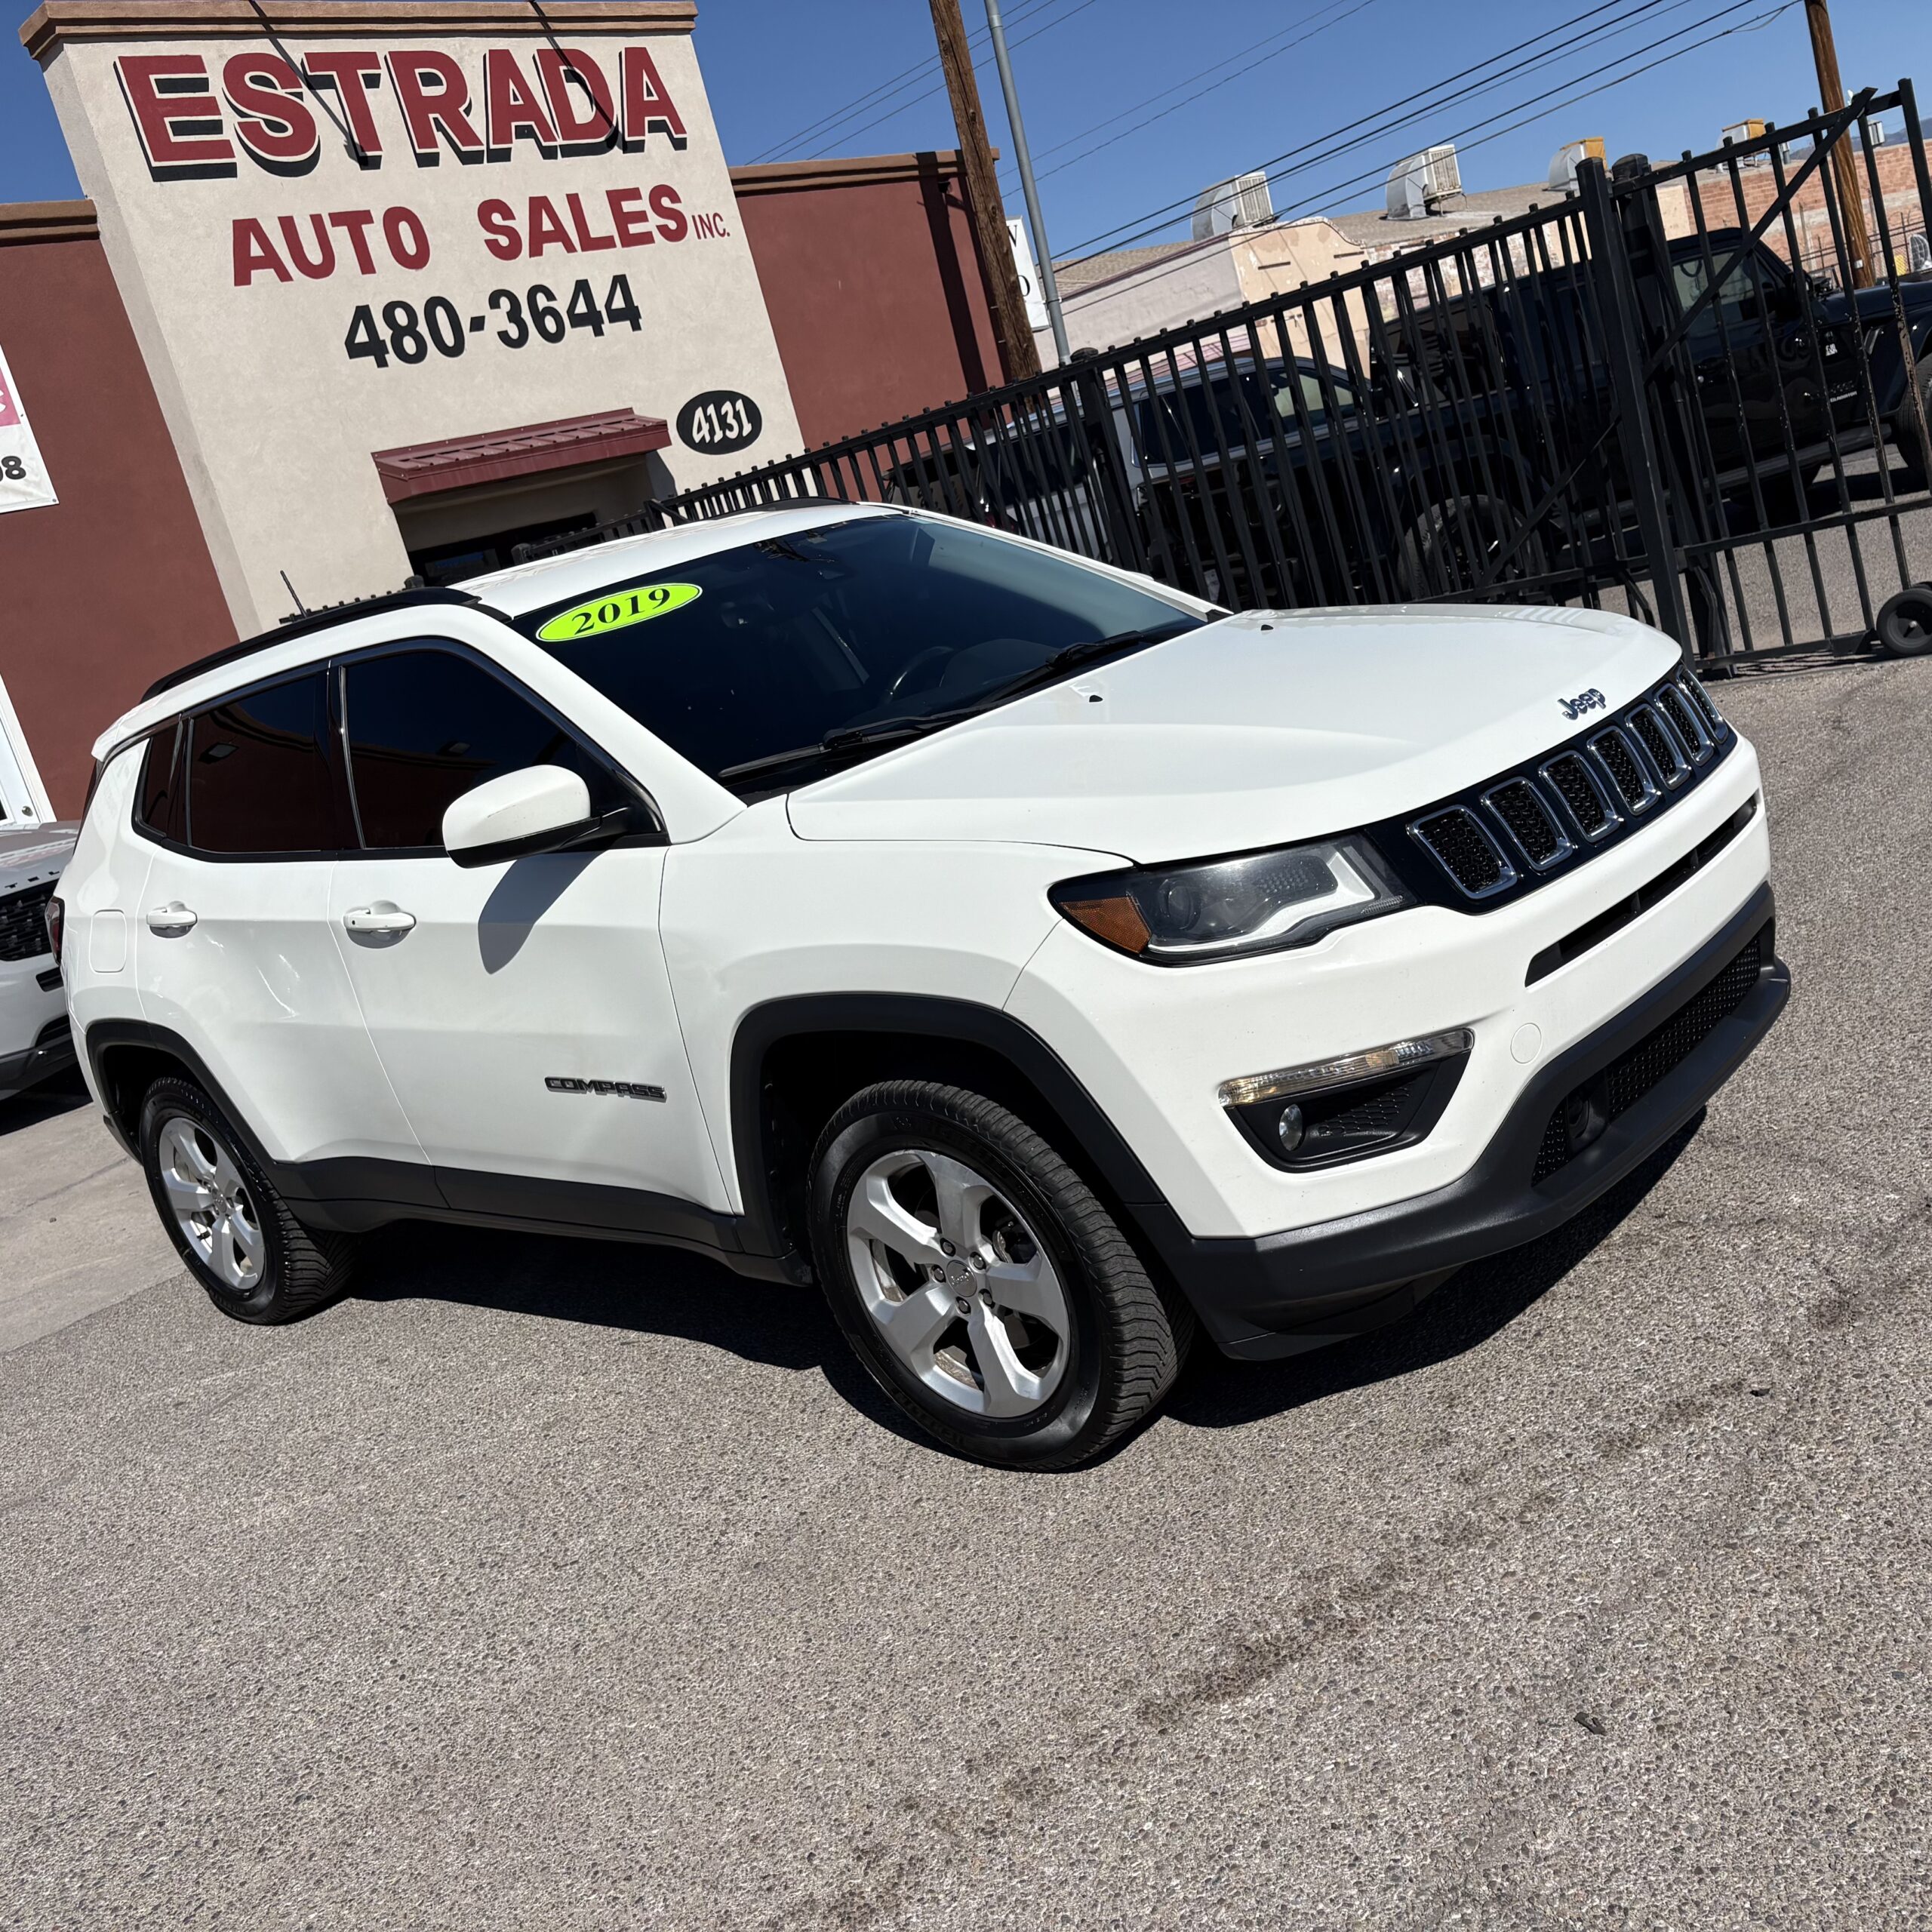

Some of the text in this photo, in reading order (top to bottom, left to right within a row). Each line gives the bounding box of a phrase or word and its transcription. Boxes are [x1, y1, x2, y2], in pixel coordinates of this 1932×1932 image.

[113, 47, 688, 183] ESTRADA
[232, 183, 731, 287] AUTO SALES INC.
[344, 273, 643, 368] 480-3644
[691, 398, 753, 444] 4131
[571, 587, 671, 635] 2019
[1558, 688, 1606, 720] Jeep
[544, 1077, 667, 1103] COMPASS
